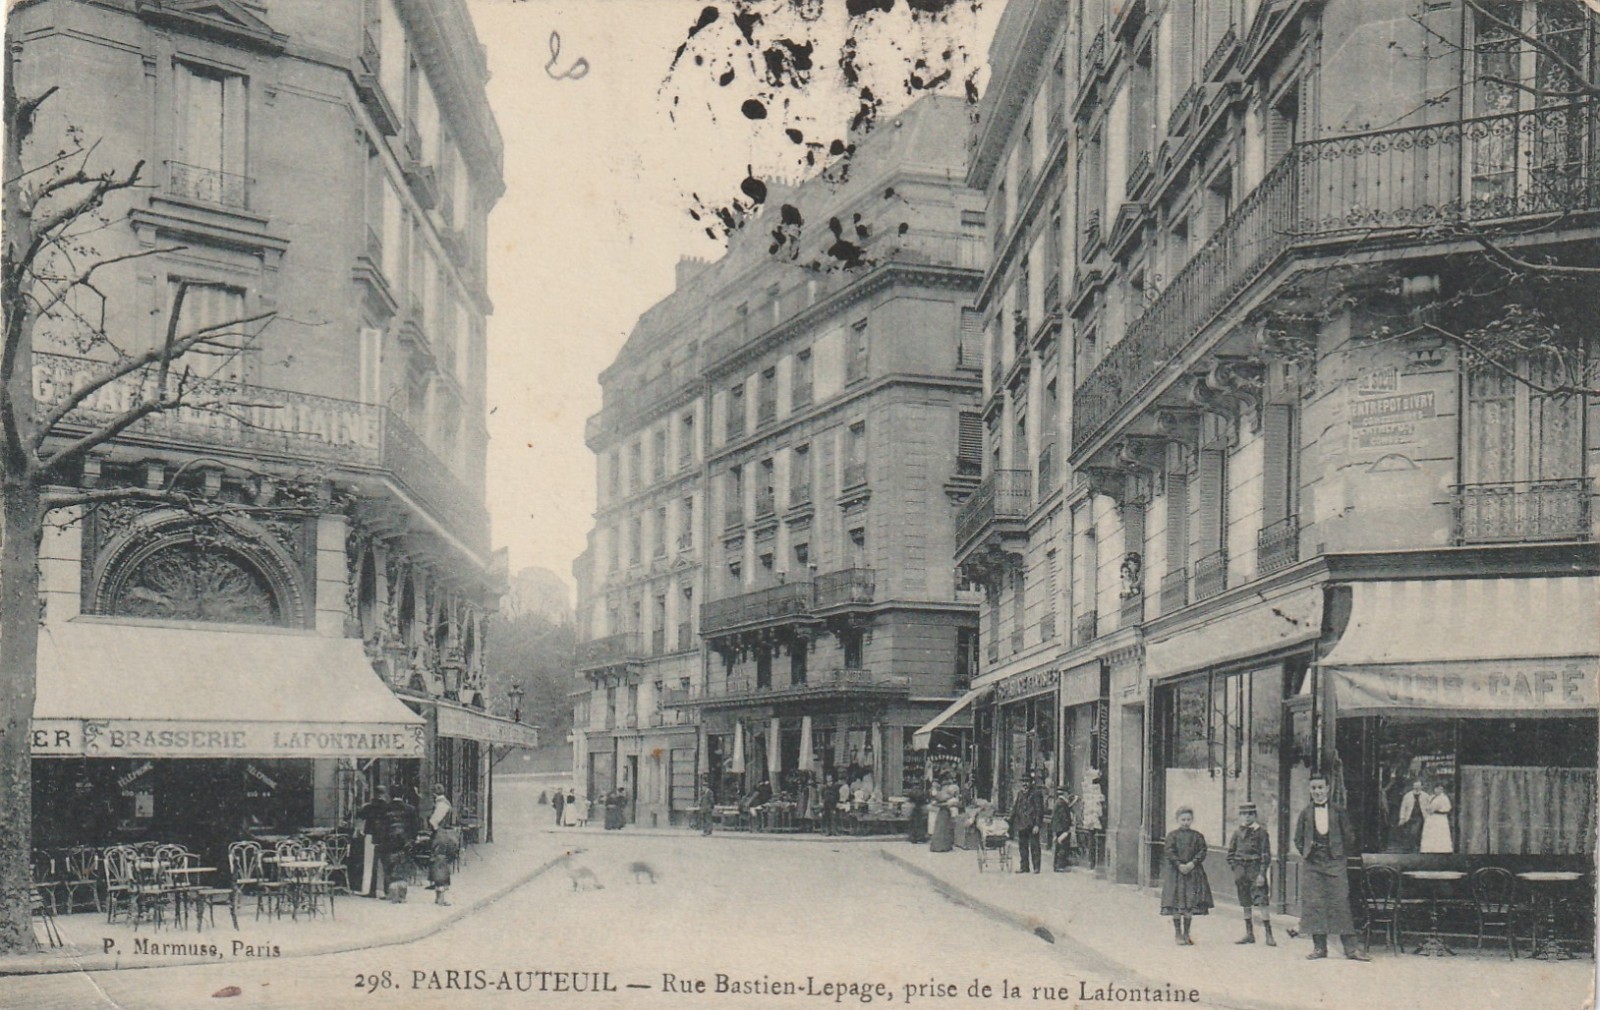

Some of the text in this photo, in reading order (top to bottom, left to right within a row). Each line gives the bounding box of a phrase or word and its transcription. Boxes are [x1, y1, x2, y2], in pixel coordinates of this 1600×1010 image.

[1487, 662, 1585, 704] CAFÉ
[109, 730, 405, 750] BRASSERIE LAFONTAINE
[1100, 704, 1109, 764] JOURNAUX
